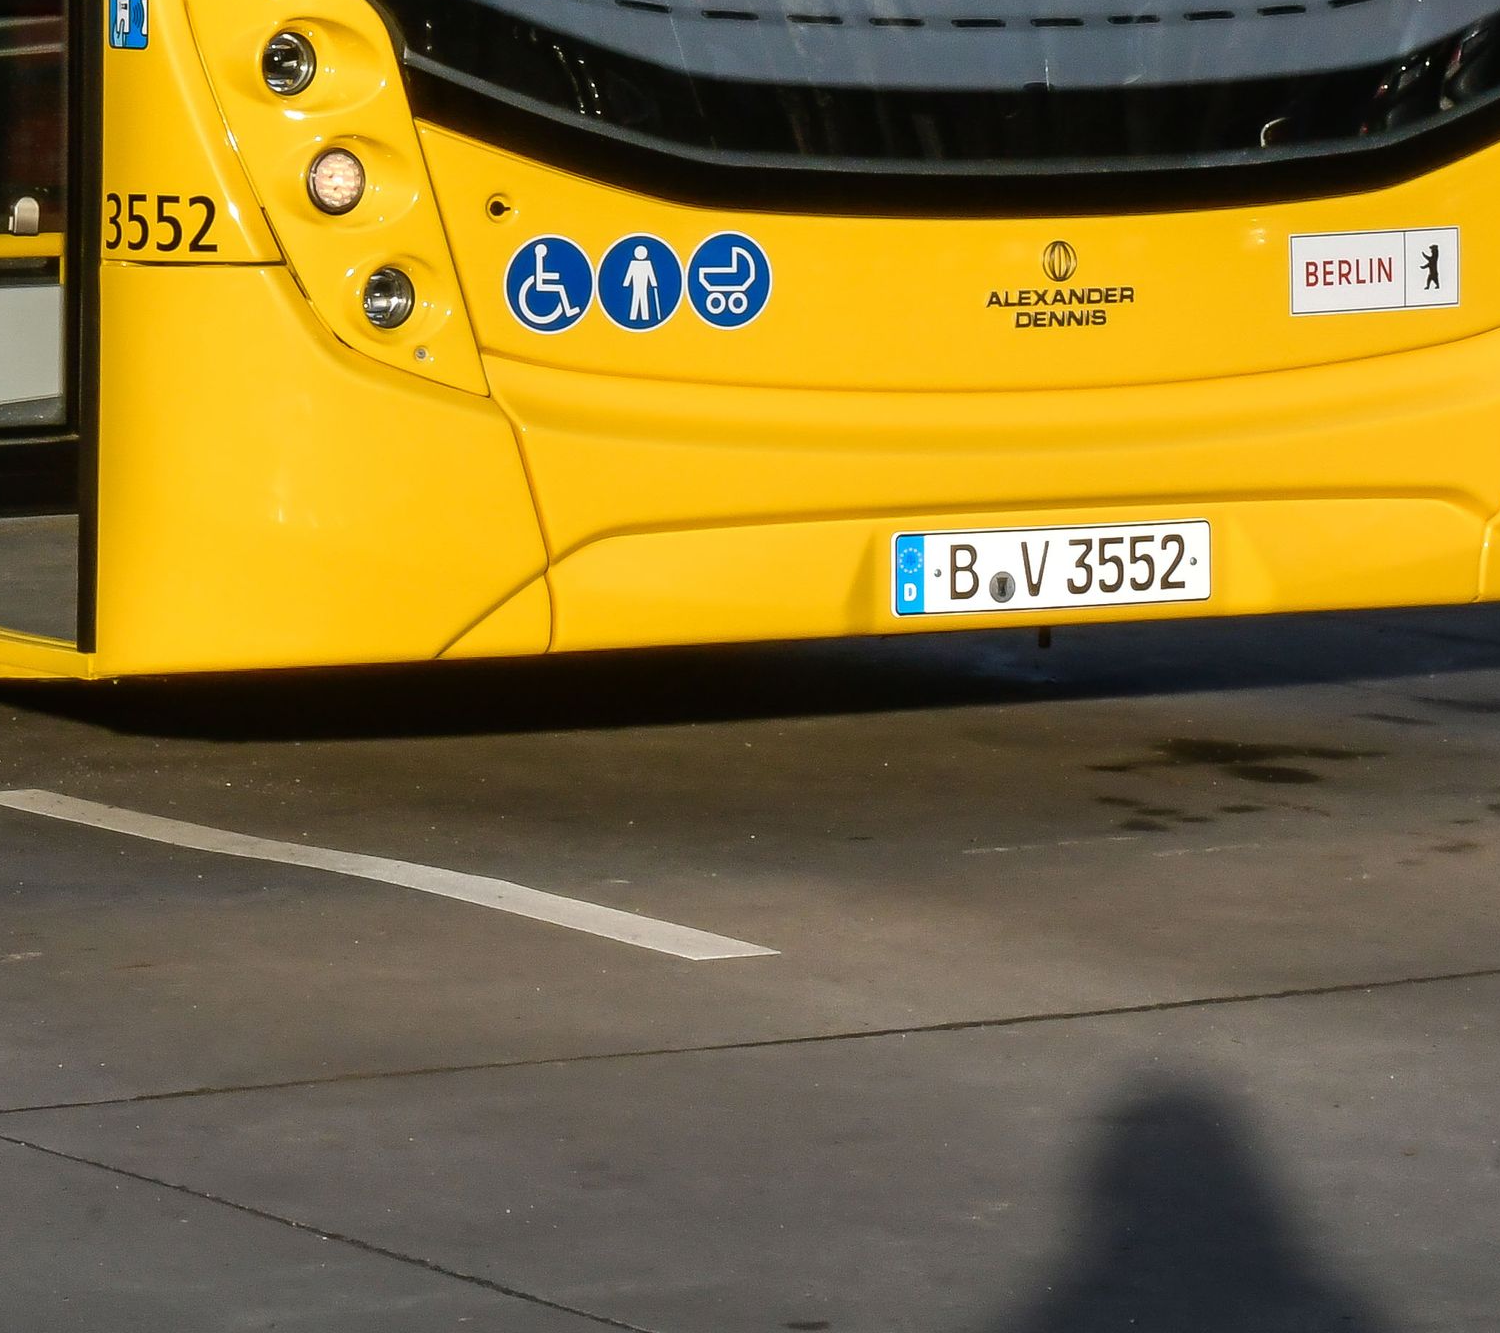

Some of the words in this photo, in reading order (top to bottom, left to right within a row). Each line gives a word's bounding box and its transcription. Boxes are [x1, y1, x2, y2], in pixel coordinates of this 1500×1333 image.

[105, 193, 218, 252] 3552
[1305, 256, 1393, 287] BERLIN
[986, 286, 1134, 308] ALEXANDER
[1015, 309, 1107, 328] DENNIS
[950, 544, 979, 600] B
[1020, 540, 1050, 597] V
[1066, 534, 1186, 595] 3552
[903, 583, 917, 601] D
